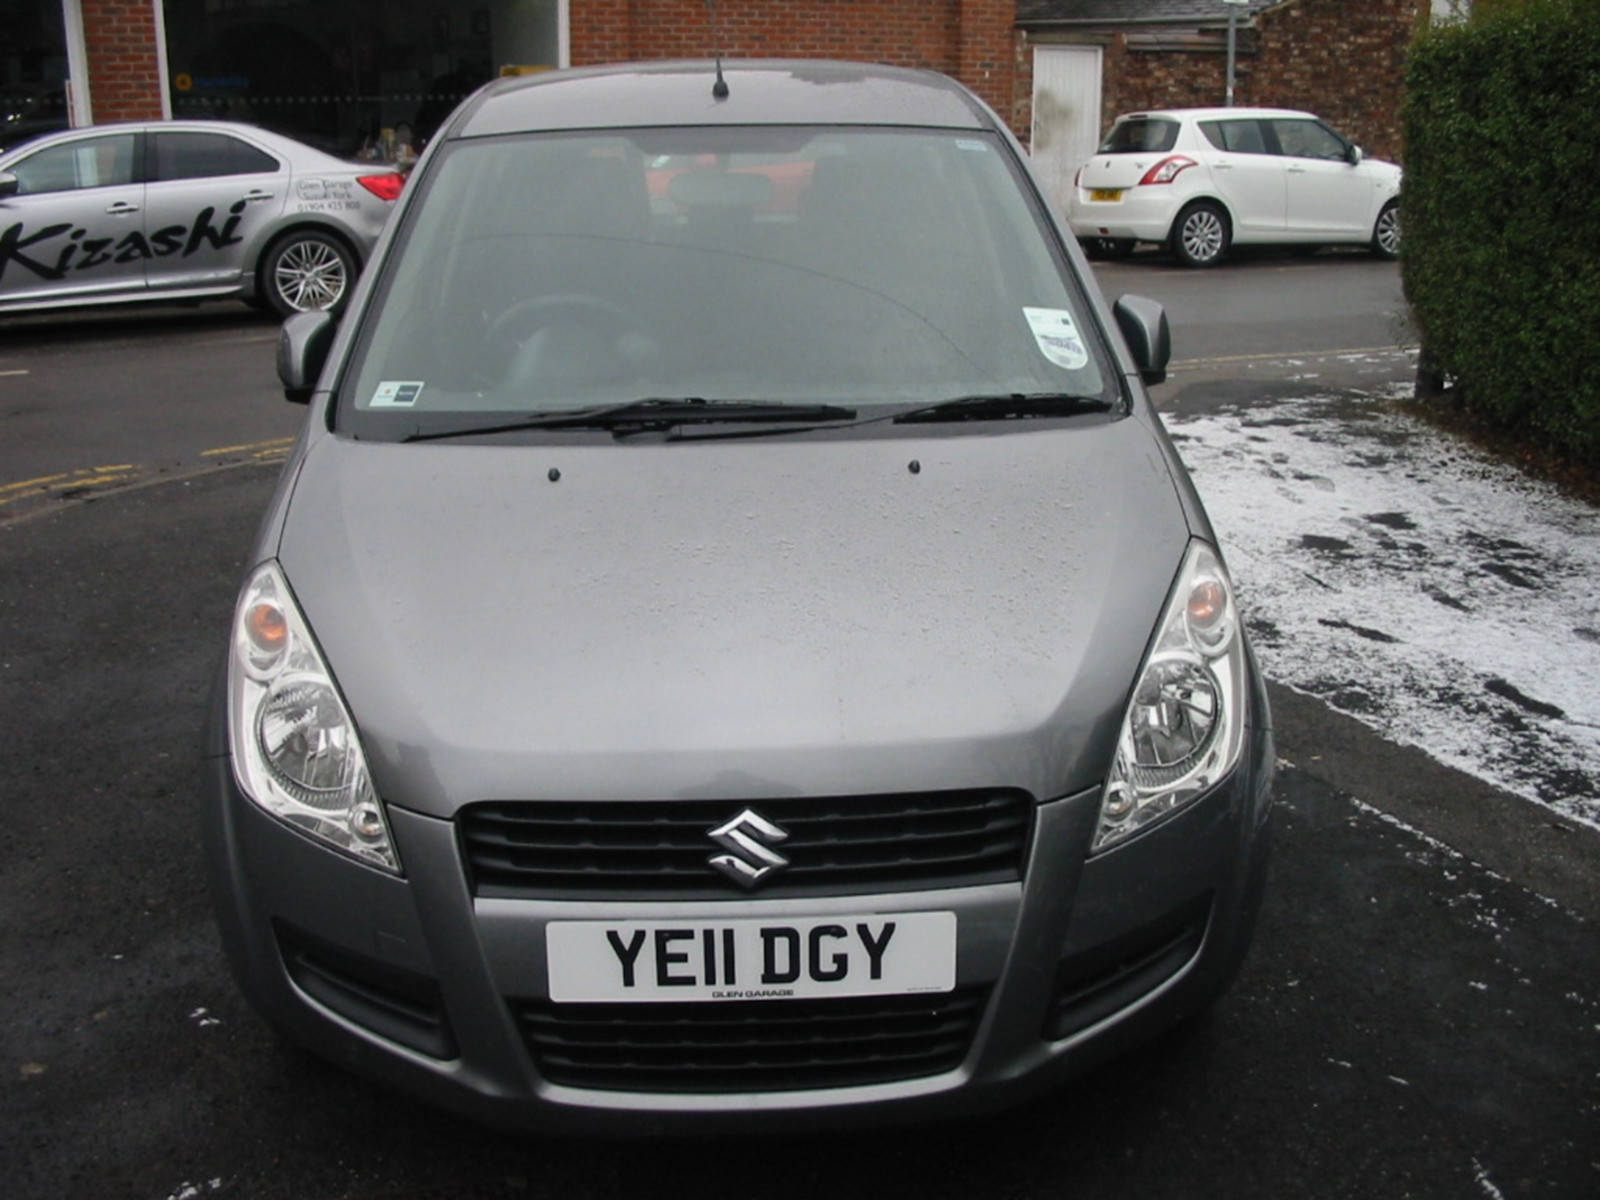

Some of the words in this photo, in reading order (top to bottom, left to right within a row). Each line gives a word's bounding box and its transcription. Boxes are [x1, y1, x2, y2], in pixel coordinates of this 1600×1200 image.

[0, 200, 246, 280] Kizashi
[760, 923, 895, 984] DGY
[712, 990, 743, 999] GLEN
[745, 989, 794, 998] GARAGE
